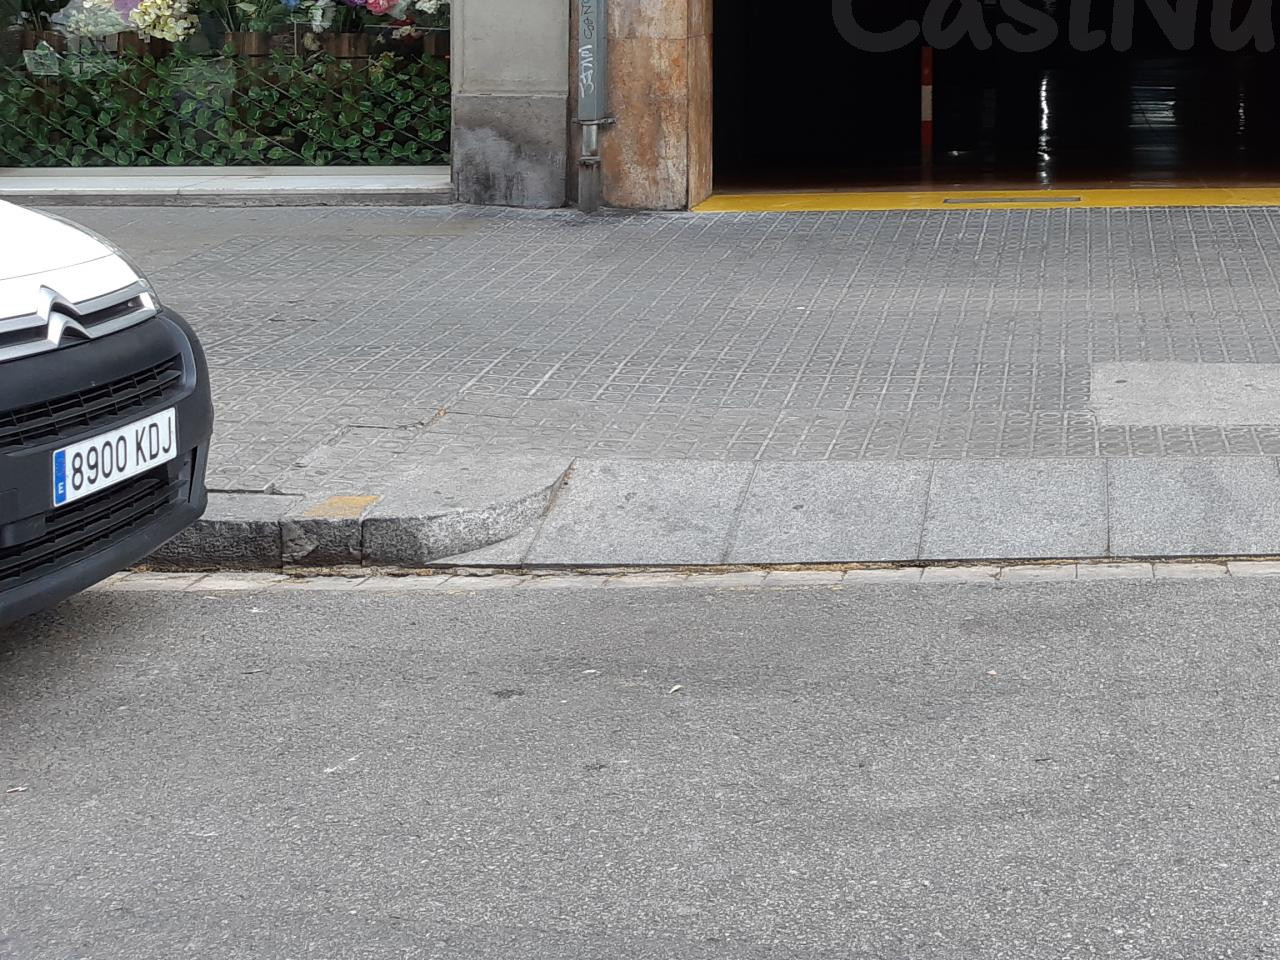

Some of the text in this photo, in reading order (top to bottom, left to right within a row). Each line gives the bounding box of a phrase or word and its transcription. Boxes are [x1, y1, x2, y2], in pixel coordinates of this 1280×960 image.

[71, 416, 172, 492] 8900 KDJ
[58, 482, 65, 494] E
